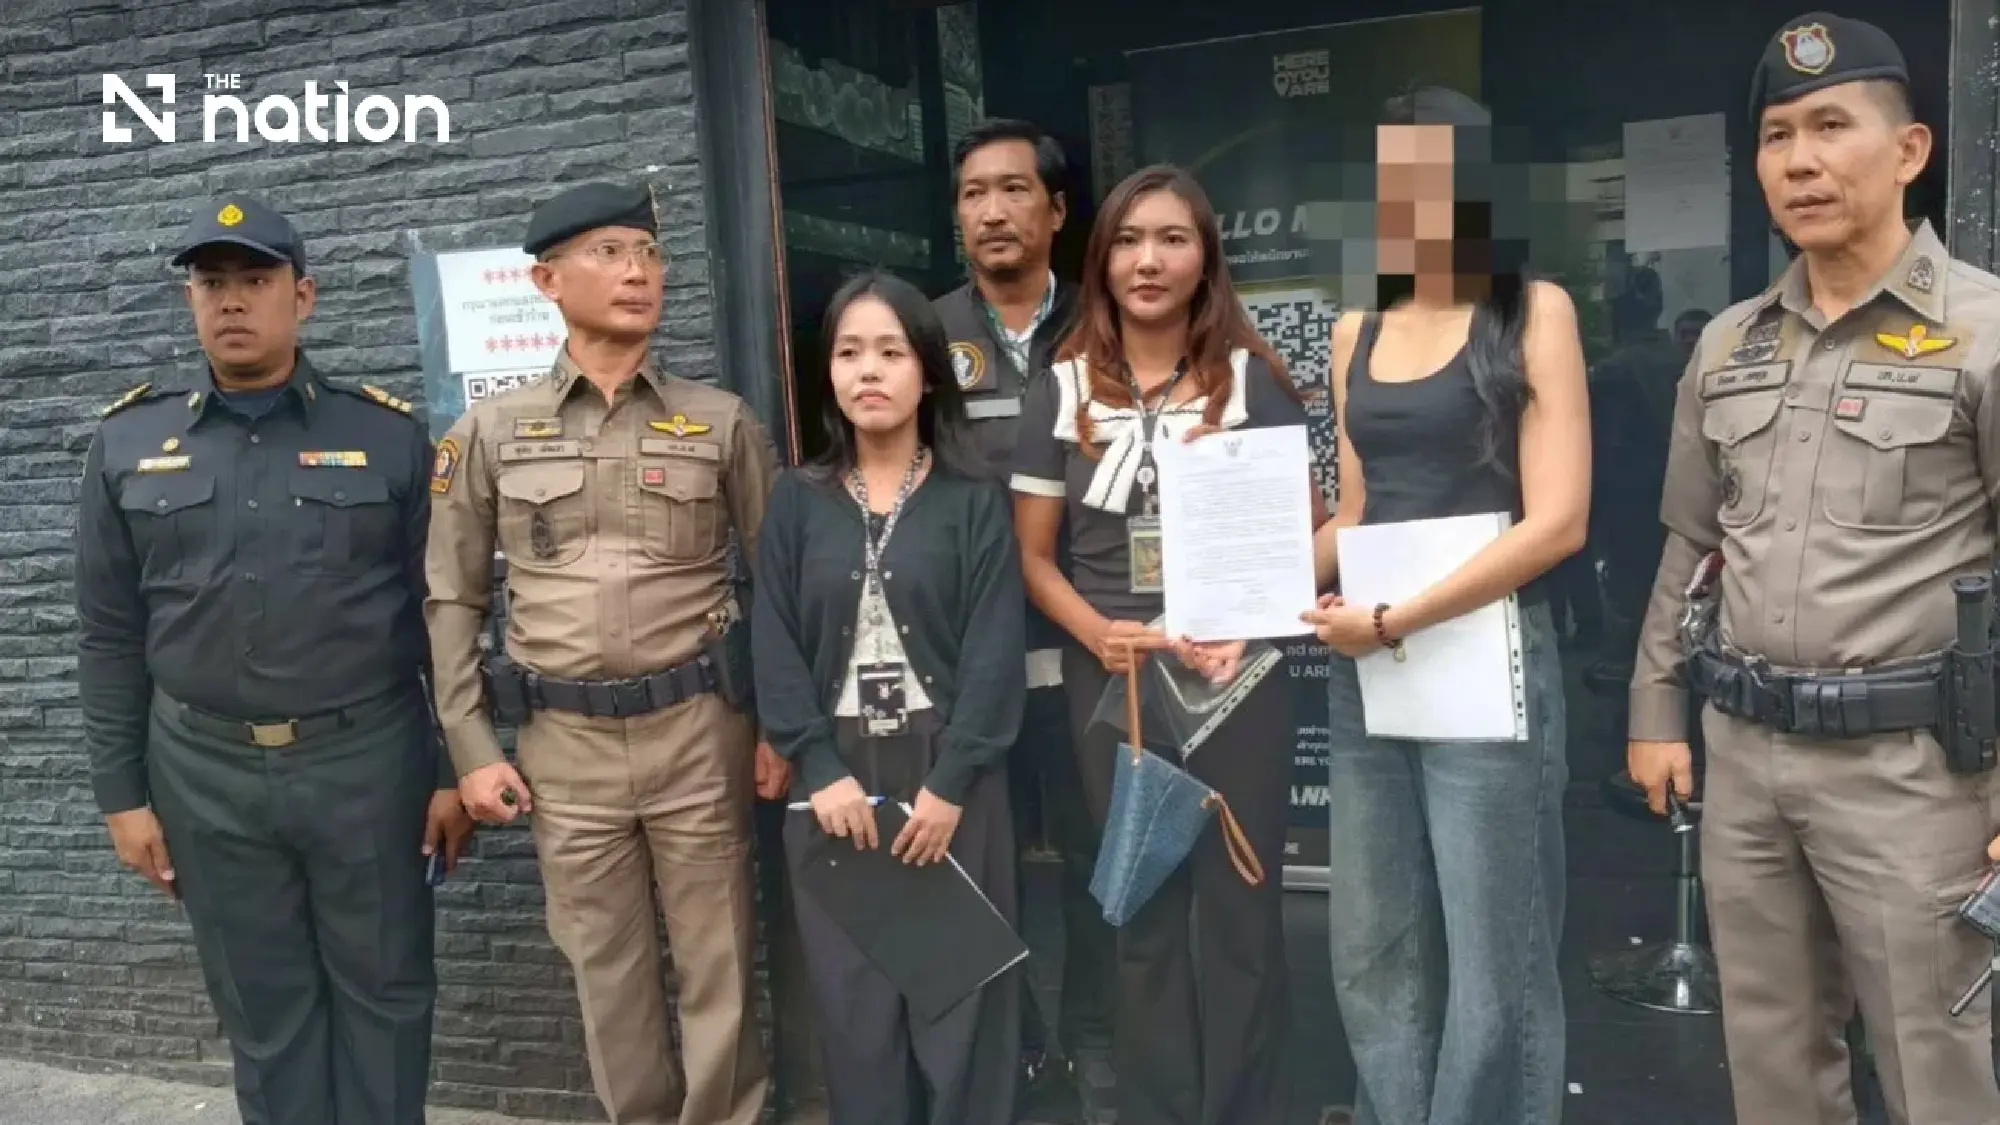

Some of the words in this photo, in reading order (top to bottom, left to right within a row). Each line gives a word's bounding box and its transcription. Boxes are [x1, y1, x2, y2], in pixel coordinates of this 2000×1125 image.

[1273, 50, 1330, 72] HERE
[1288, 67, 1330, 84] YOU
[1289, 80, 1330, 97] ARE
